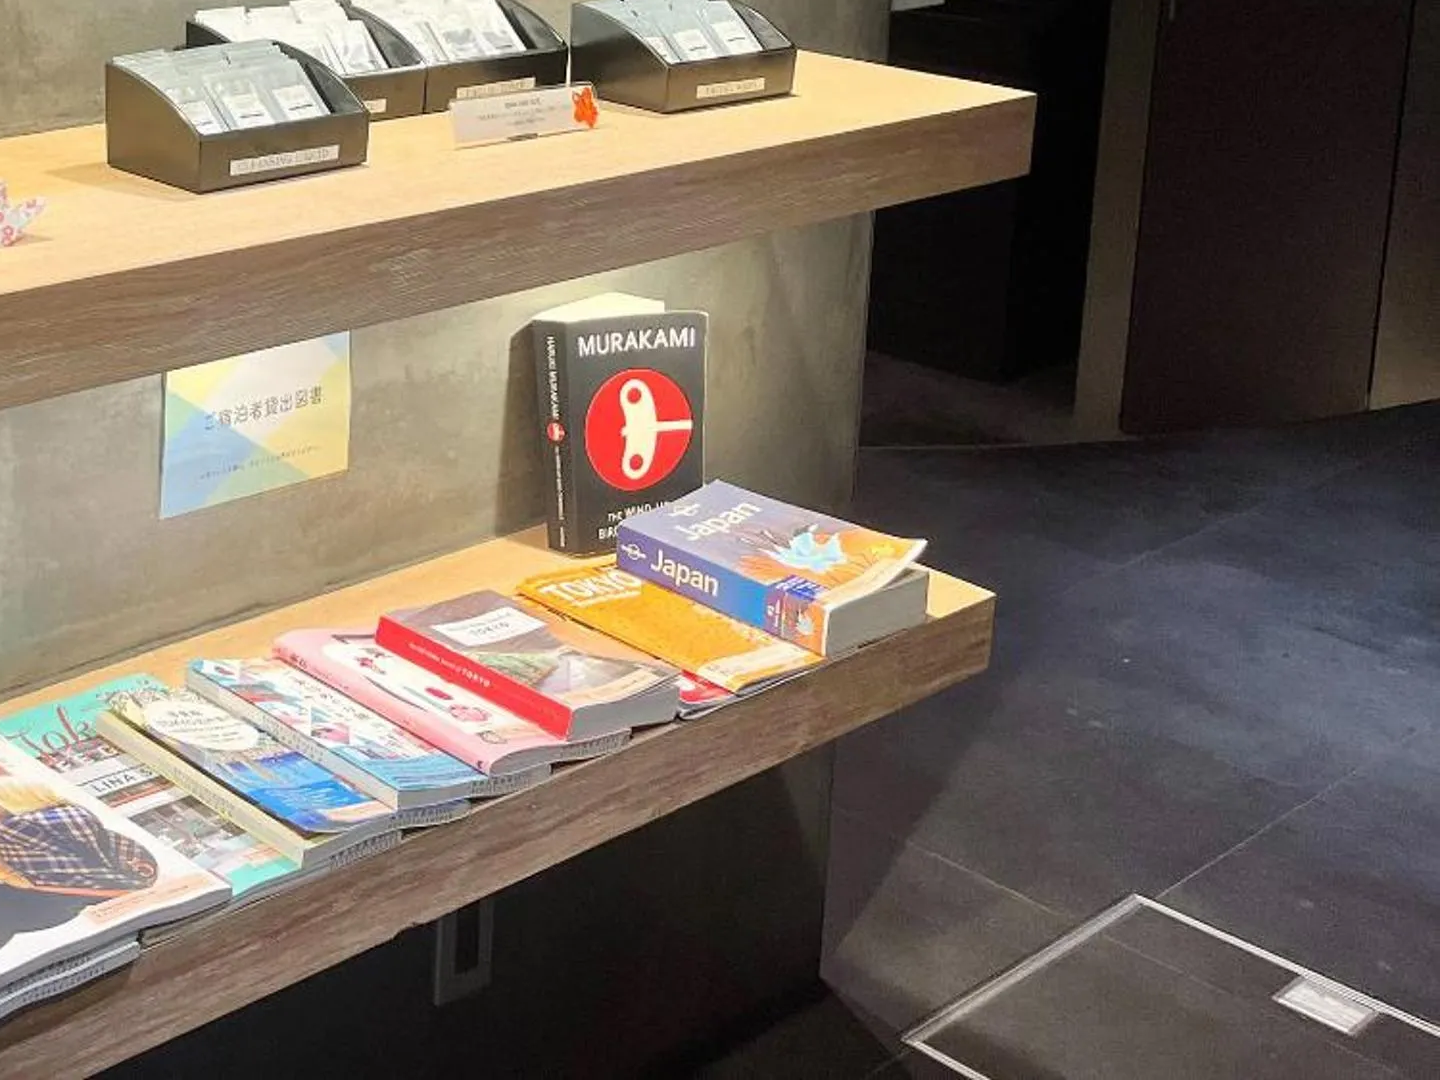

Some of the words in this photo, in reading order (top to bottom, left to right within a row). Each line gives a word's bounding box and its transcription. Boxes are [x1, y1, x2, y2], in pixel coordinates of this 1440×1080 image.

[577, 326, 697, 358] MURAKAMI
[607, 511, 623, 522] THE
[673, 500, 764, 542] Japan
[539, 570, 642, 602] TOKYO
[649, 548, 720, 598] Japan
[4, 703, 97, 763] Tok
[91, 772, 138, 794] LINA
